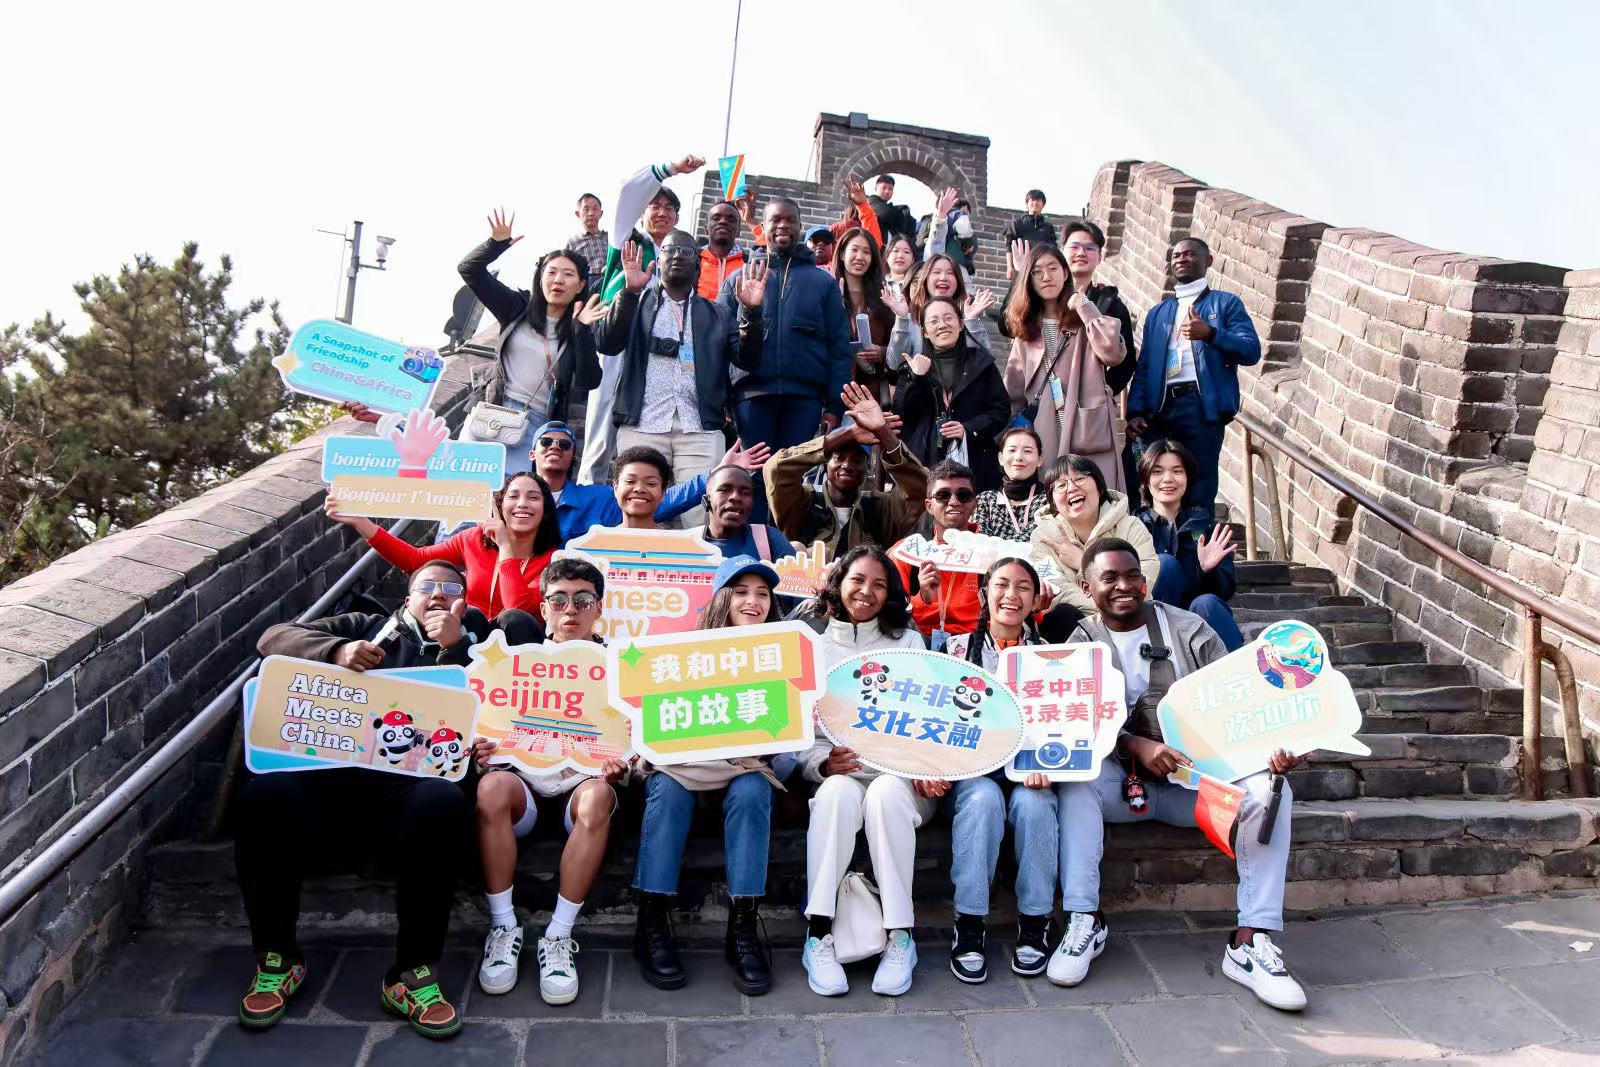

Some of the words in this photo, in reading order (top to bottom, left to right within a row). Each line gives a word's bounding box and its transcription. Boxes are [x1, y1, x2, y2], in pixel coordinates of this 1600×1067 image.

[305, 343, 370, 369] Friendship
[311, 332, 321, 341] A
[322, 333, 380, 358] Snapshot
[380, 351, 396, 363] of
[311, 360, 413, 401] China&Africa
[331, 450, 400, 471] bonjour
[429, 456, 444, 471] la
[447, 456, 499, 474] Chine
[337, 487, 405, 505] Bonjour
[606, 588, 683, 612] nese
[592, 616, 644, 638] ory
[512, 654, 579, 680] Lens
[588, 664, 606, 681] o
[649, 643, 783, 684] 我和中国
[288, 672, 369, 704] Africa
[468, 678, 585, 719] Beijing
[891, 677, 955, 708] 中非
[1193, 672, 1255, 713] 北京
[284, 696, 363, 729] Meets
[658, 688, 770, 732] 的故事
[1223, 692, 1322, 744] 欢迎你
[279, 721, 356, 753] China
[851, 705, 983, 750] 文化交融
